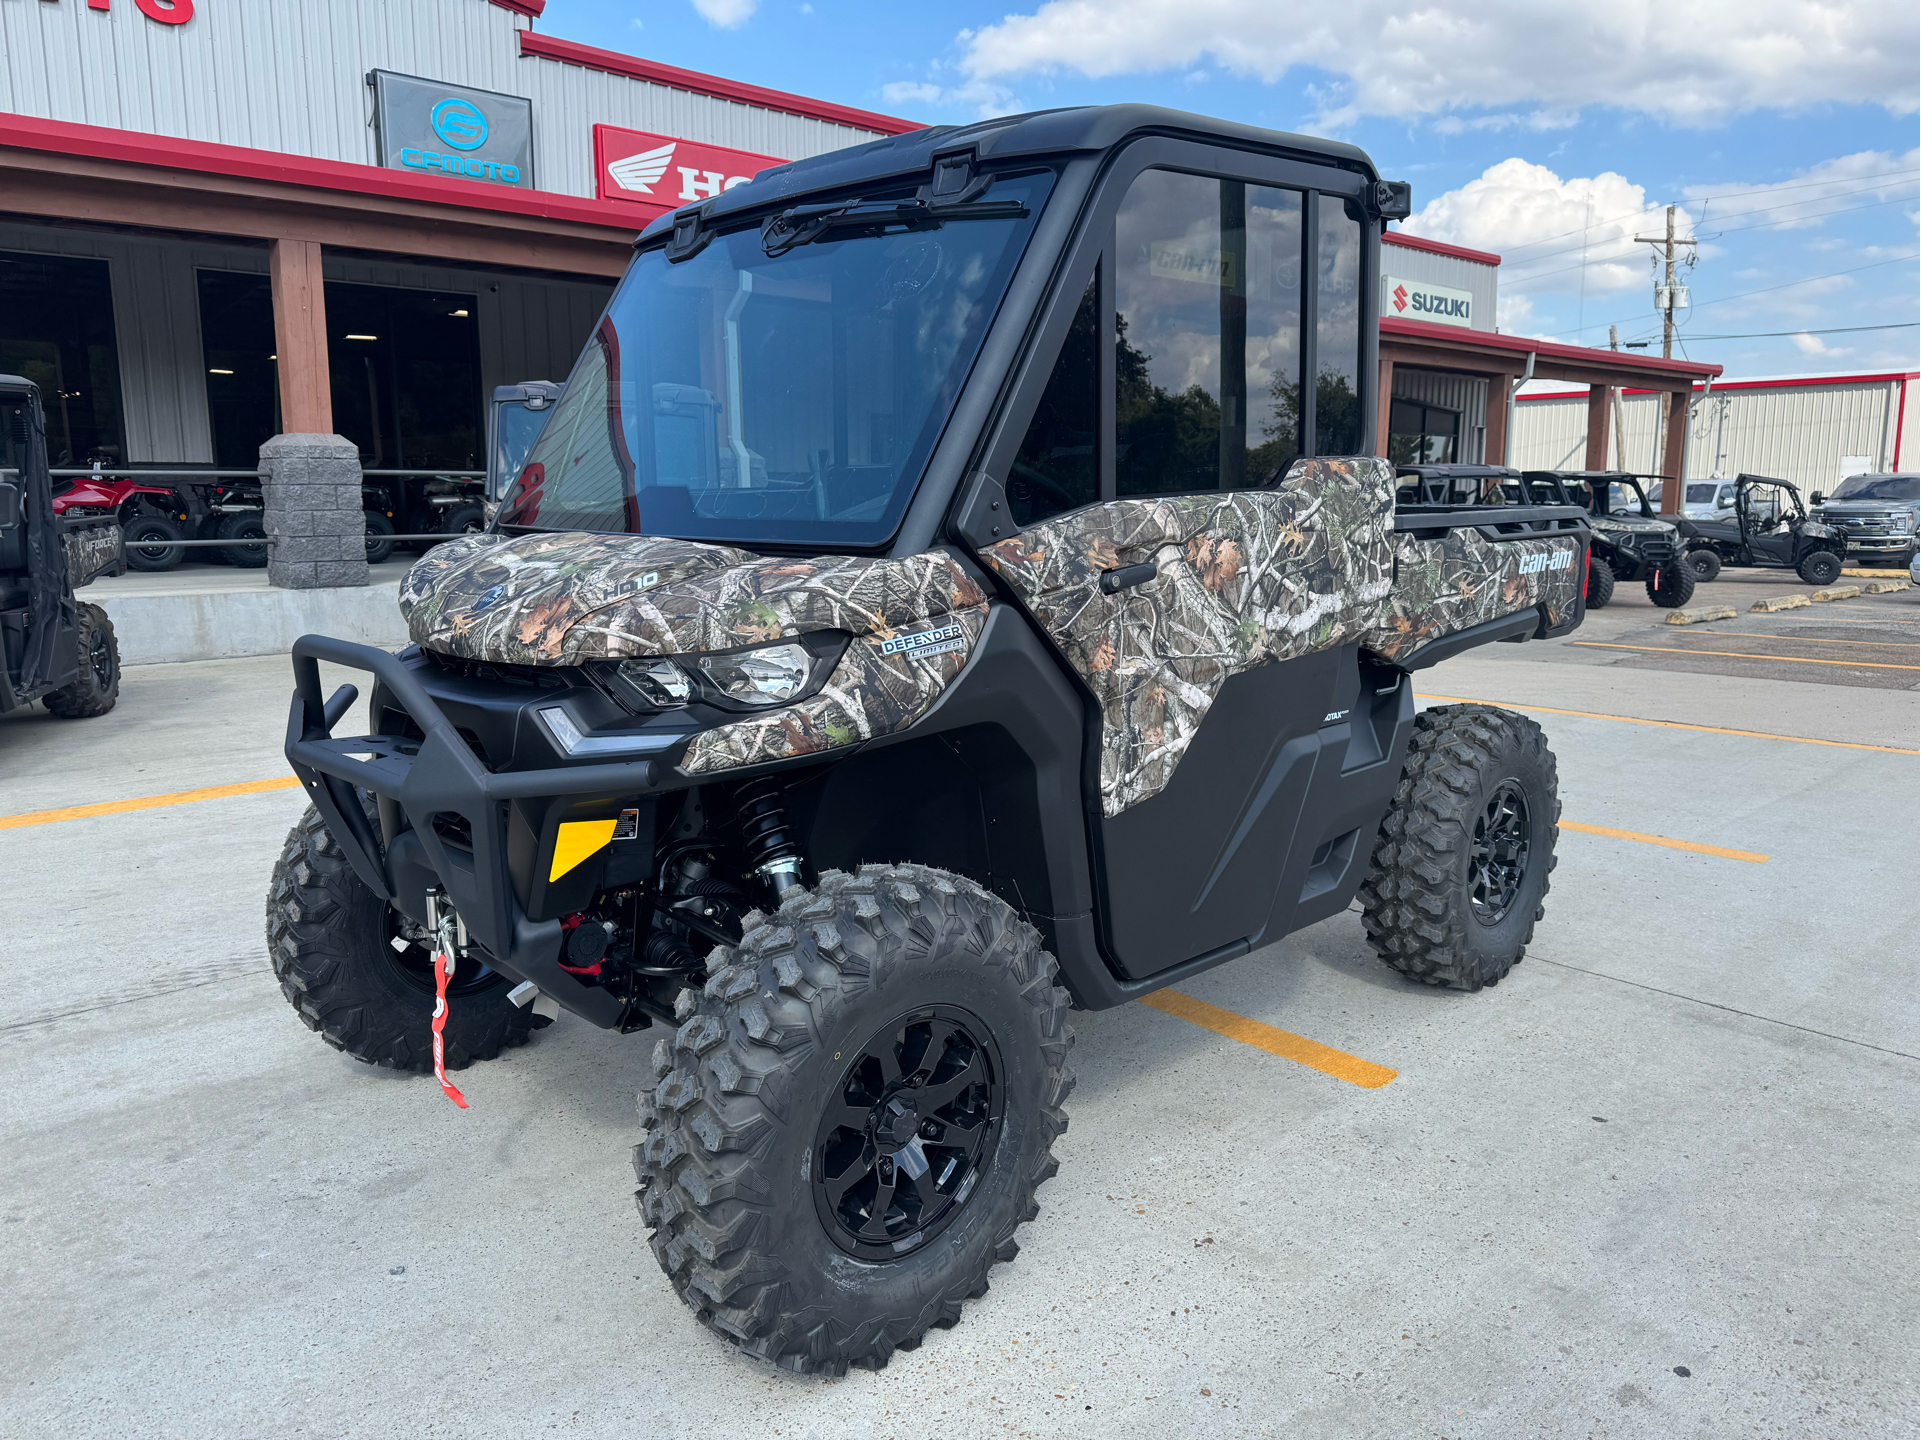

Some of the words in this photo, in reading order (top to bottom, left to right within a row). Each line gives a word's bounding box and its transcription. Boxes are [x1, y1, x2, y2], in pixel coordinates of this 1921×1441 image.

[400, 147, 520, 184] CFMOTO
[1156, 250, 1230, 277] can-am
[1411, 291, 1470, 319] SUZUKI
[1518, 550, 1573, 575] can-am
[883, 626, 961, 653] DEFENDER
[911, 641, 961, 658] LIMITED
